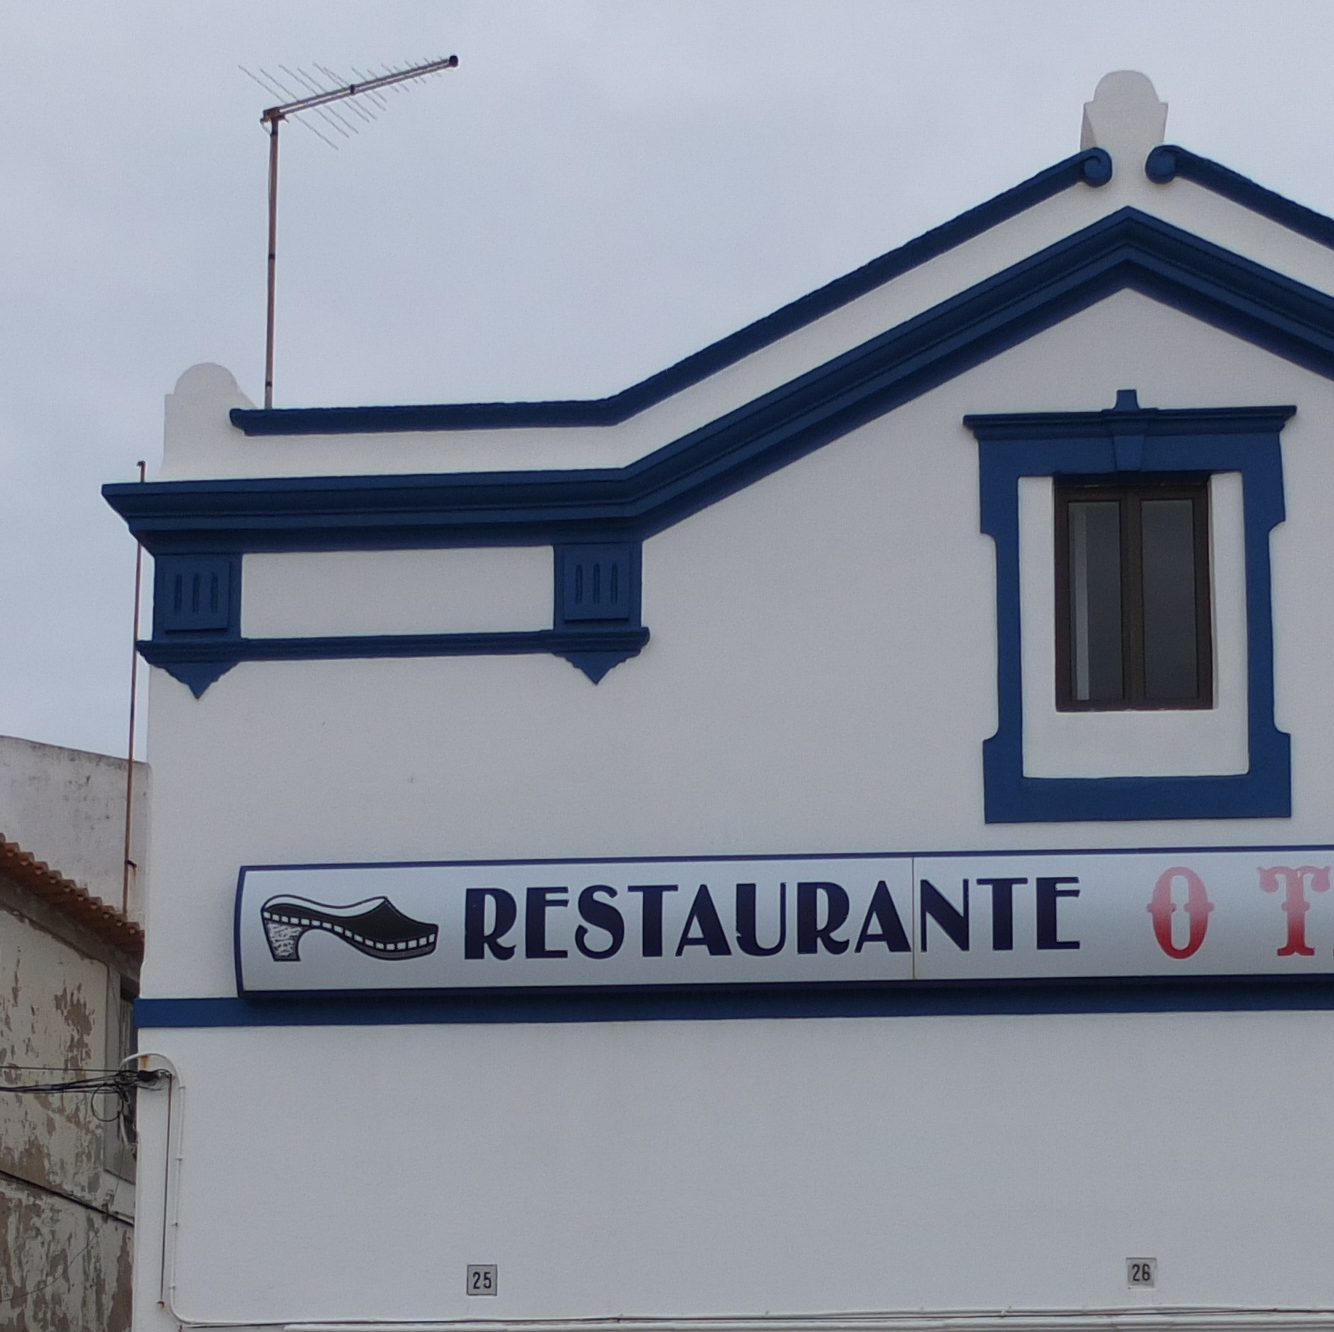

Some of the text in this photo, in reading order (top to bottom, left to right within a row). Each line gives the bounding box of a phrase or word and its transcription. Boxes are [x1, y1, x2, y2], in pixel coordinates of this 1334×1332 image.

[464, 876, 1081, 961] RESTAURANTE
[1145, 865, 1215, 960] O
[472, 1271, 492, 1290] 25
[1132, 1263, 1151, 1282] 26
